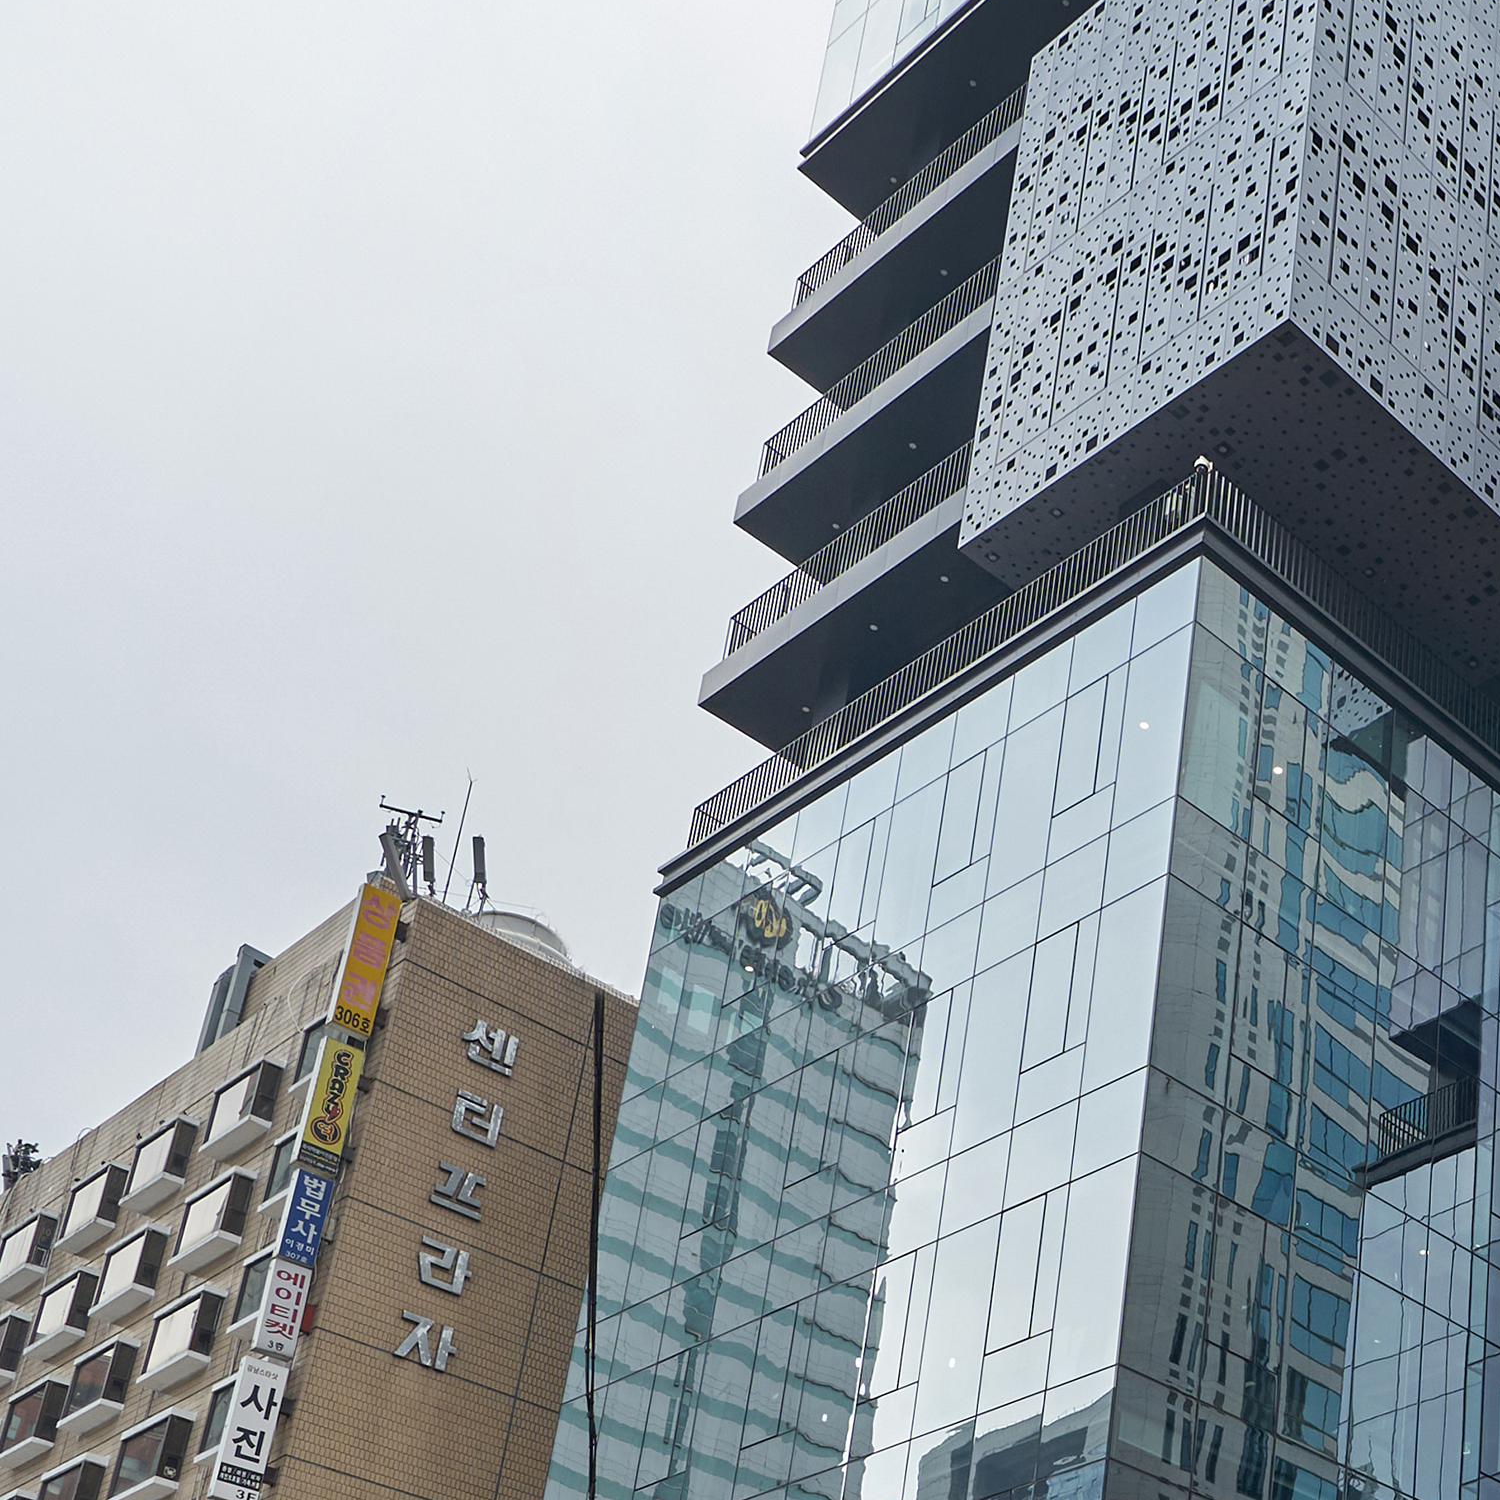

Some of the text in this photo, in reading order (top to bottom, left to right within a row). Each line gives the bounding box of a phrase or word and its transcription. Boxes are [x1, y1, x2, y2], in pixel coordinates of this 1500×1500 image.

[342, 894, 398, 1014] 상품권
[335, 1005, 371, 1034] 306호
[290, 1174, 327, 1244] 법무사
[395, 1018, 520, 1373] 센터프라자
[265, 1270, 306, 1340] 에이티켓
[231, 1384, 278, 1464] 사진
[235, 1489, 257, 1500] 3F
